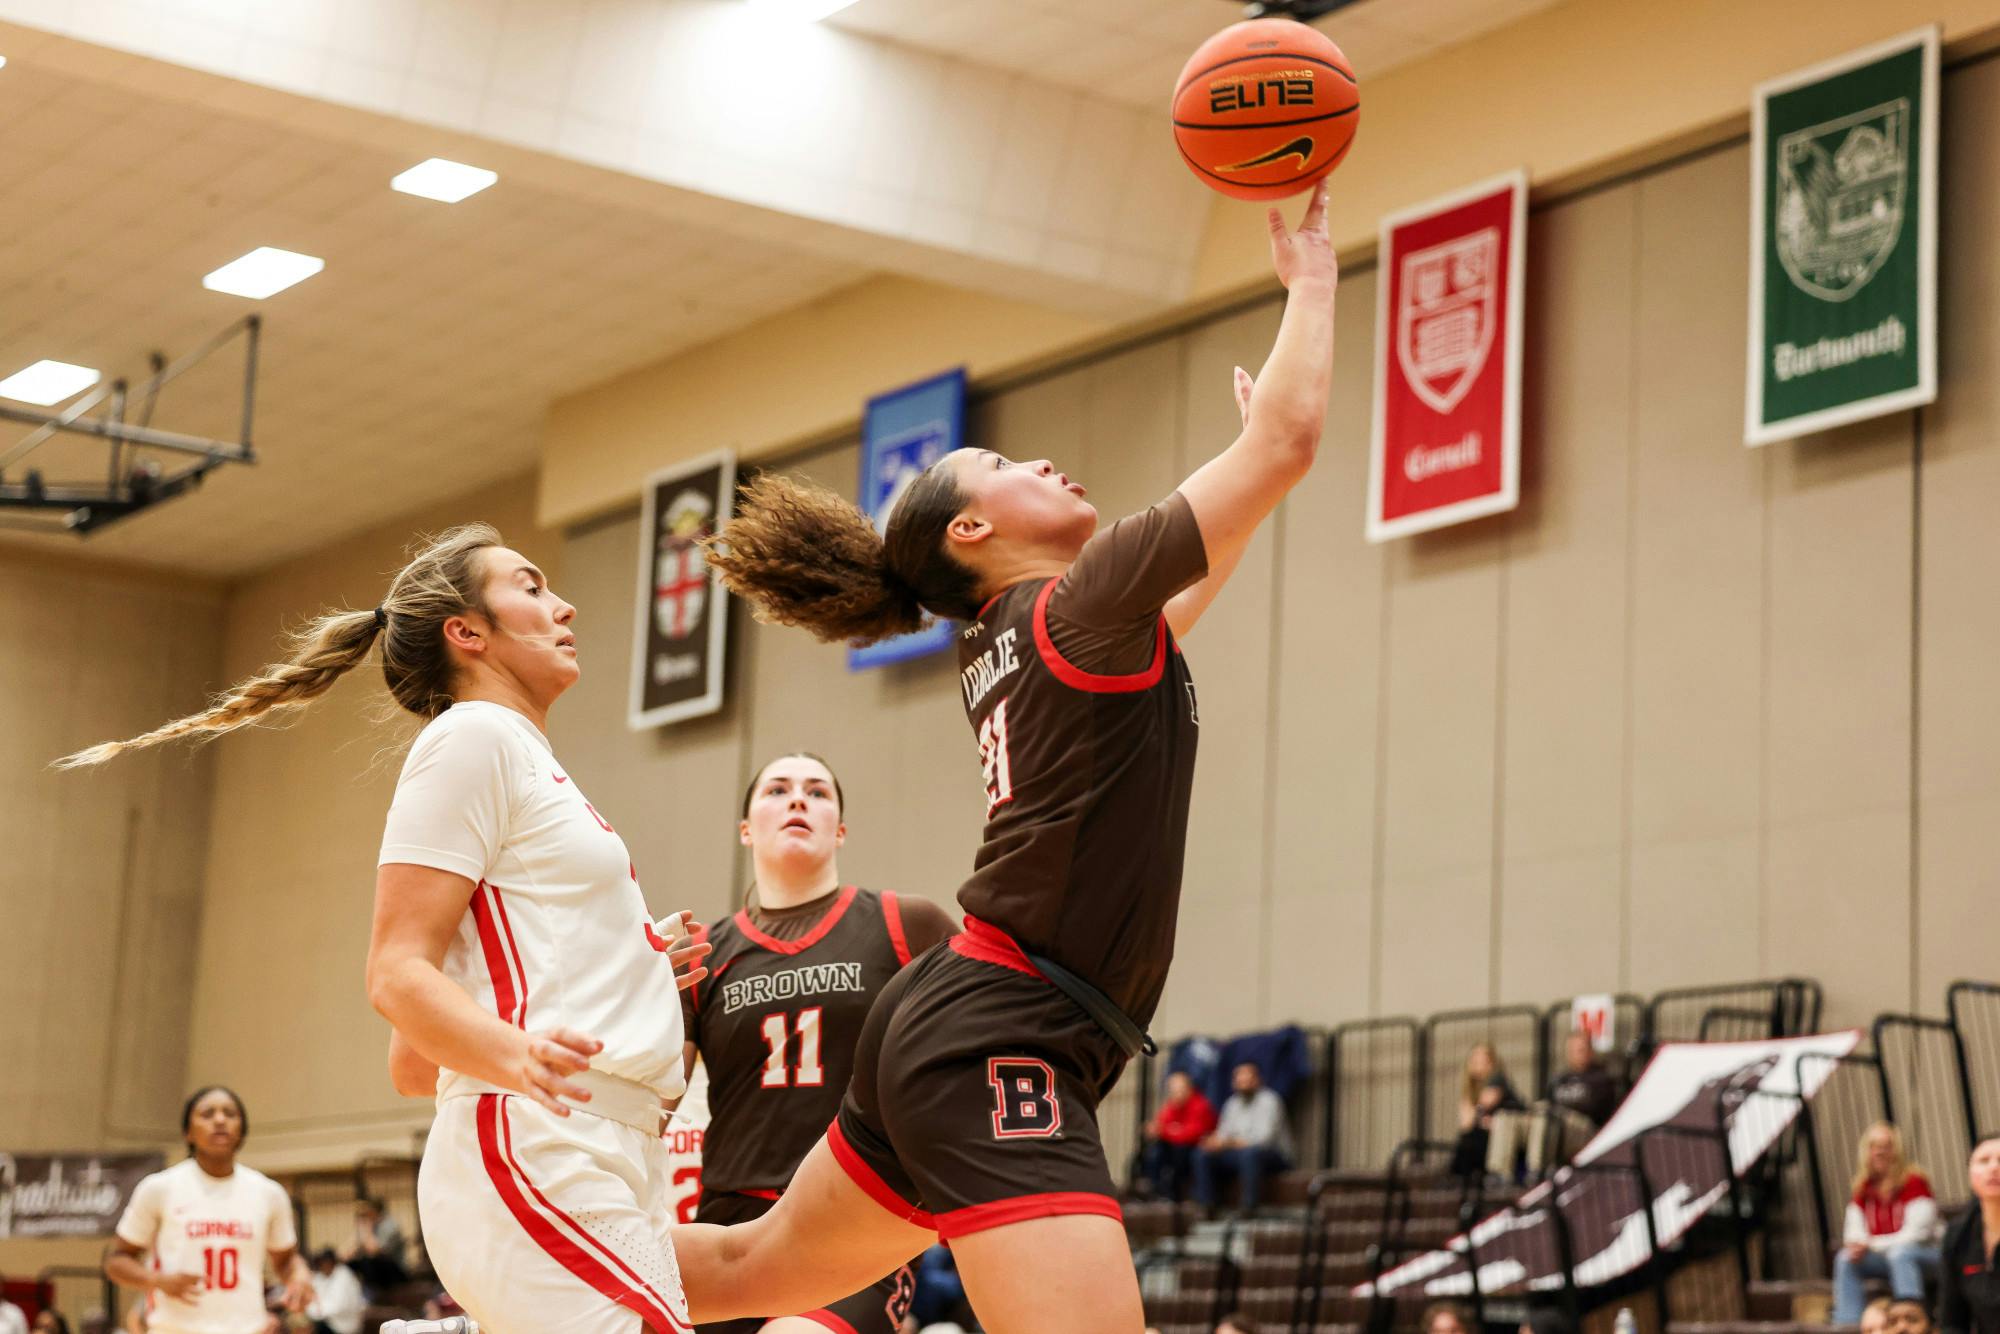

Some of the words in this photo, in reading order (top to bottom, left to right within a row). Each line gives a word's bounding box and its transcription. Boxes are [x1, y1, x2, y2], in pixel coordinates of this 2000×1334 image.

[1210, 79, 1314, 113] ELITE
[1774, 314, 1906, 382] Dartmouth
[1404, 431, 1482, 483] Cornell
[723, 963, 861, 1014] BROWN
[760, 1006, 824, 1089] 11
[987, 1056, 1062, 1140] B
[203, 1248, 238, 1290] 10
